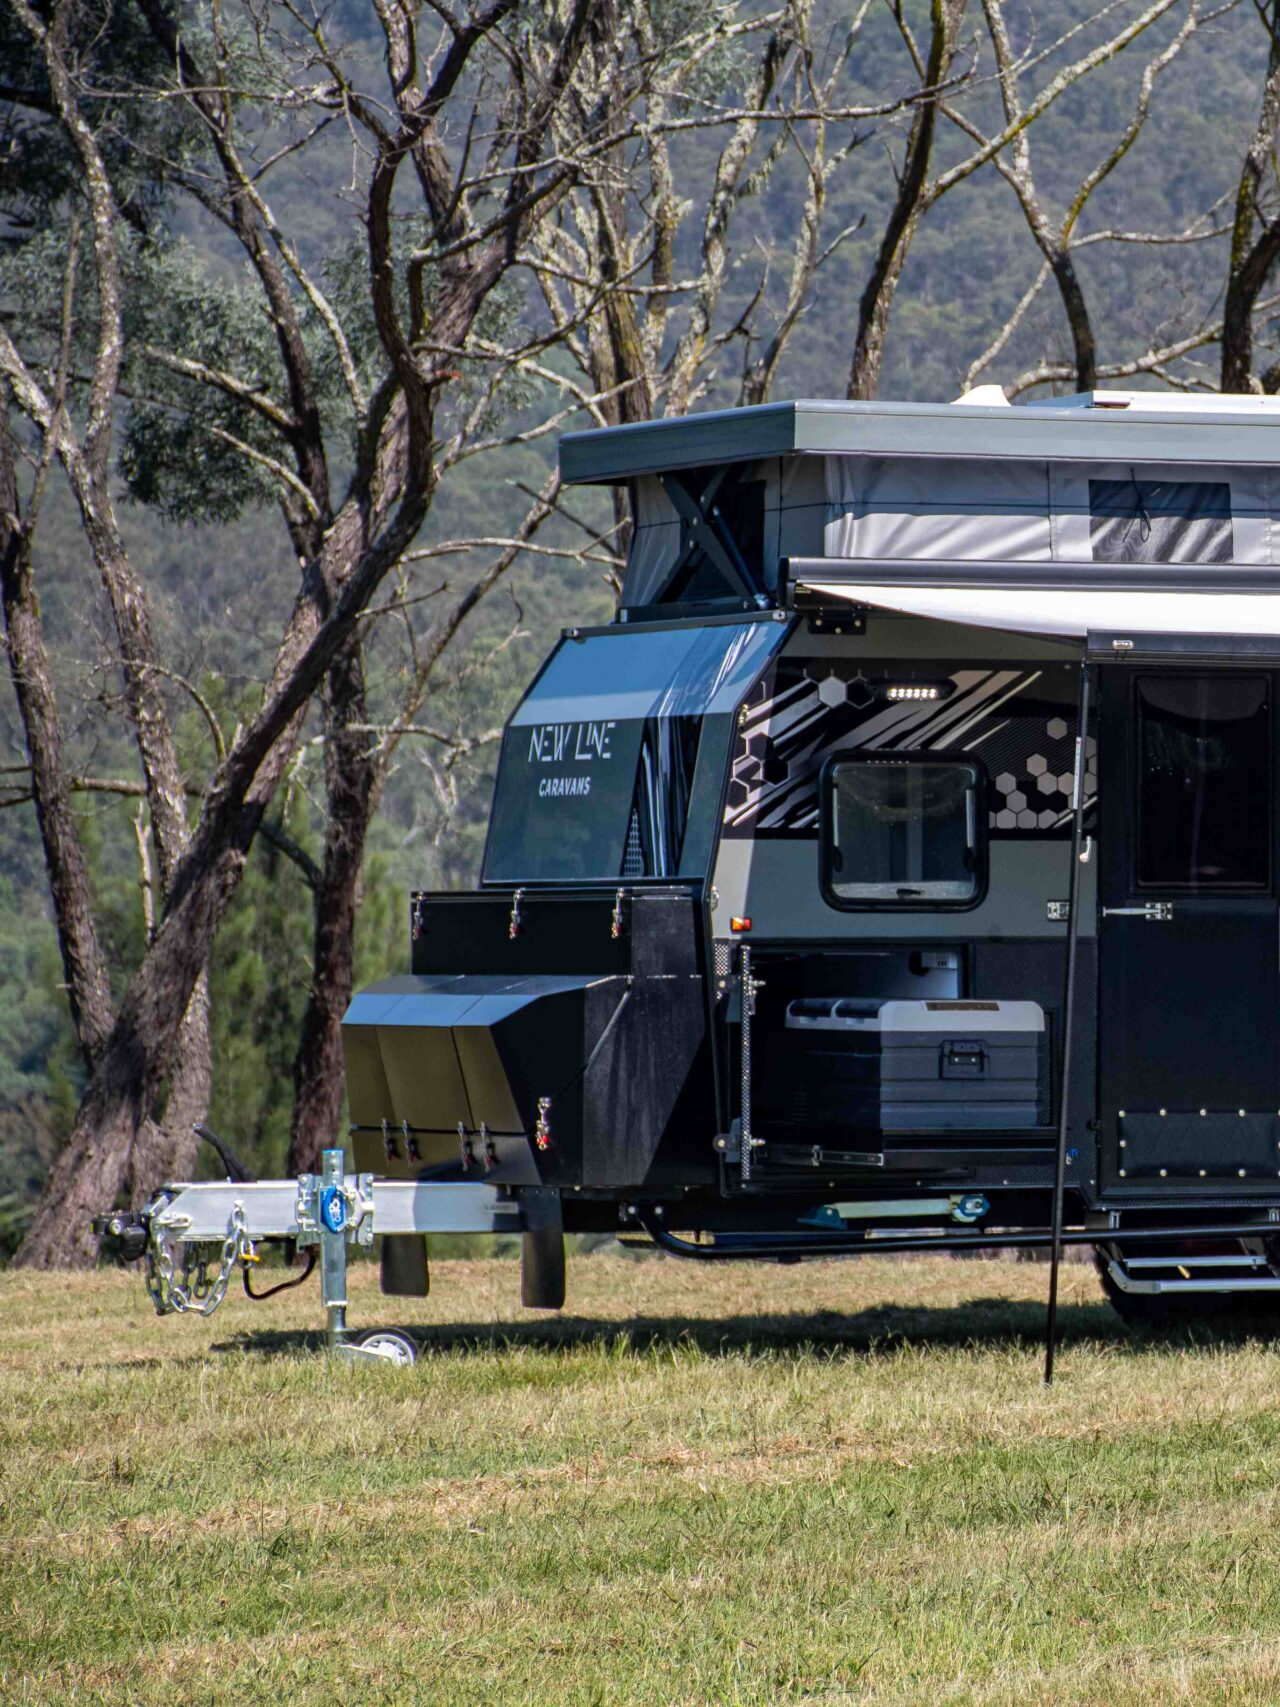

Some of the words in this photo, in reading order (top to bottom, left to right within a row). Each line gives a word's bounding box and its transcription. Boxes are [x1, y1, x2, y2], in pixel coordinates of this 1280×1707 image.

[528, 724, 573, 763] NEW
[574, 721, 617, 761] LINE
[538, 776, 591, 797] CARAVANS
